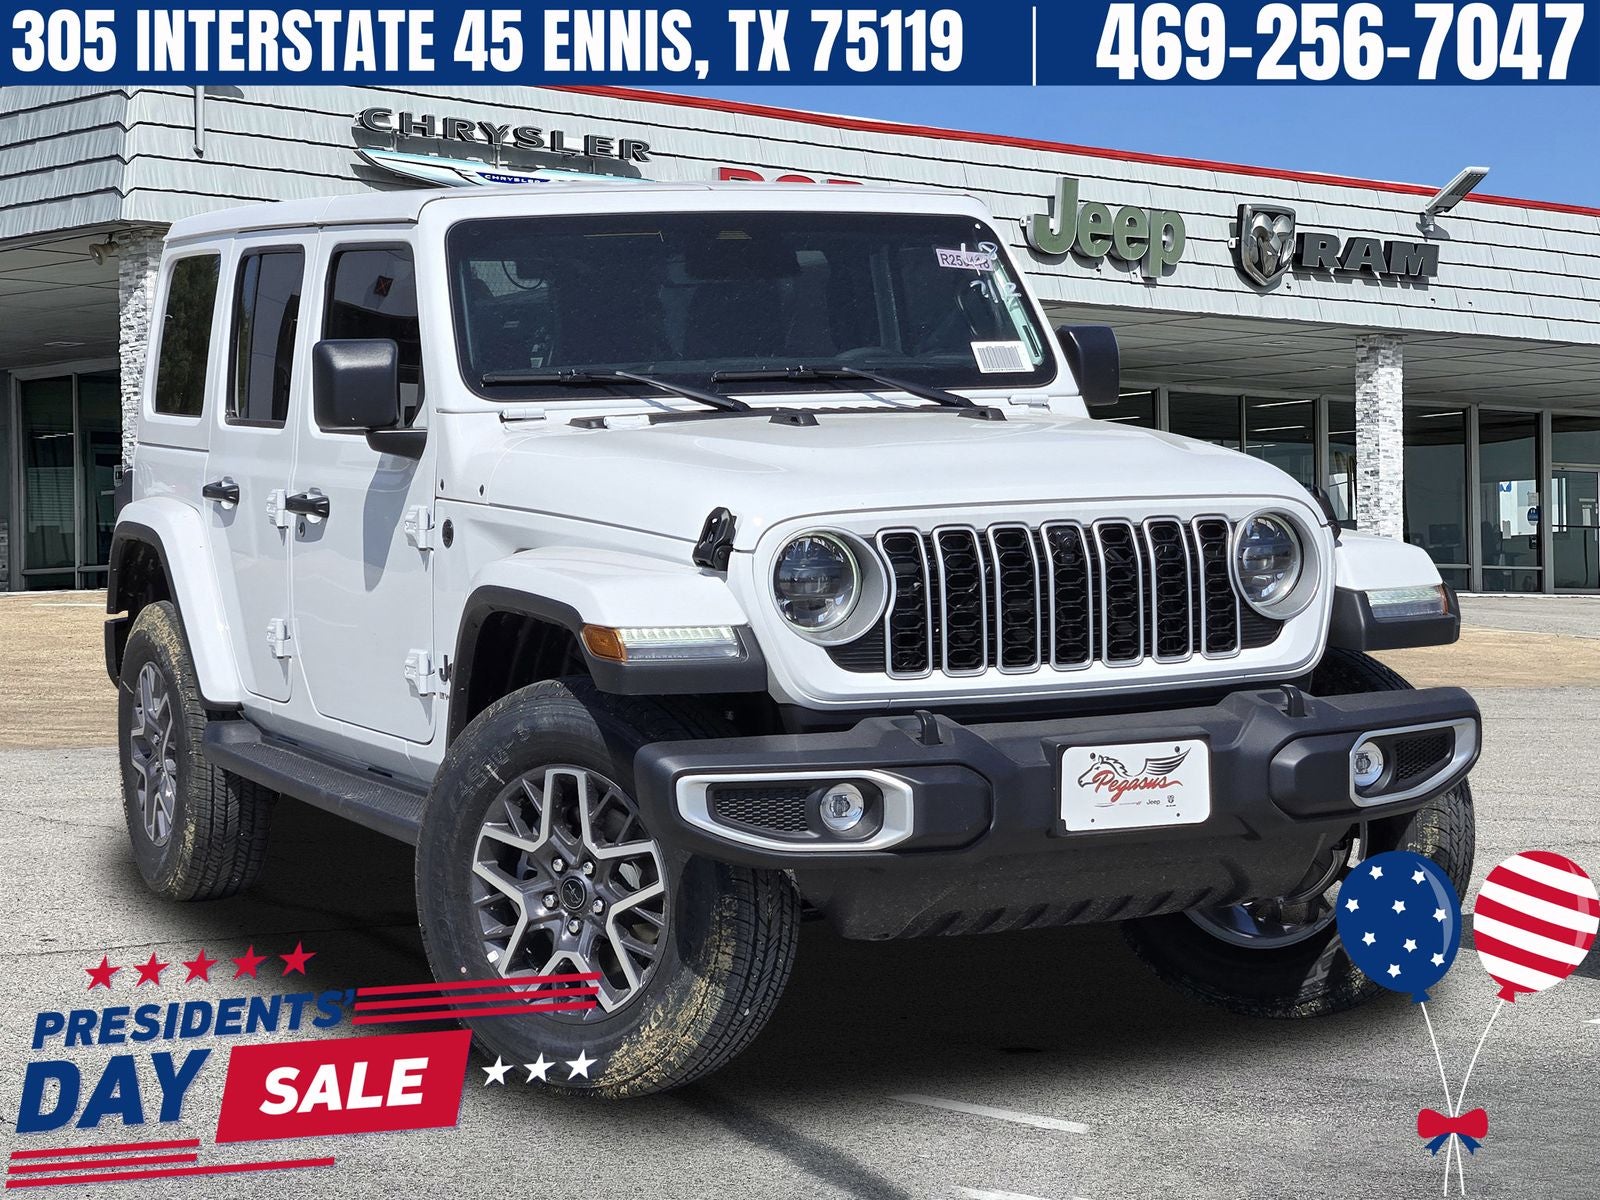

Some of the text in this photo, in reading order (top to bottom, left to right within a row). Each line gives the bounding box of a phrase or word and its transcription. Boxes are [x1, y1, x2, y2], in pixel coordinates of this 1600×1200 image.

[357, 107, 651, 163] CHRYSLER
[1025, 176, 1186, 279] Jeep
[1295, 232, 1440, 277] RAM
[1092, 769, 1183, 803] Pegasus
